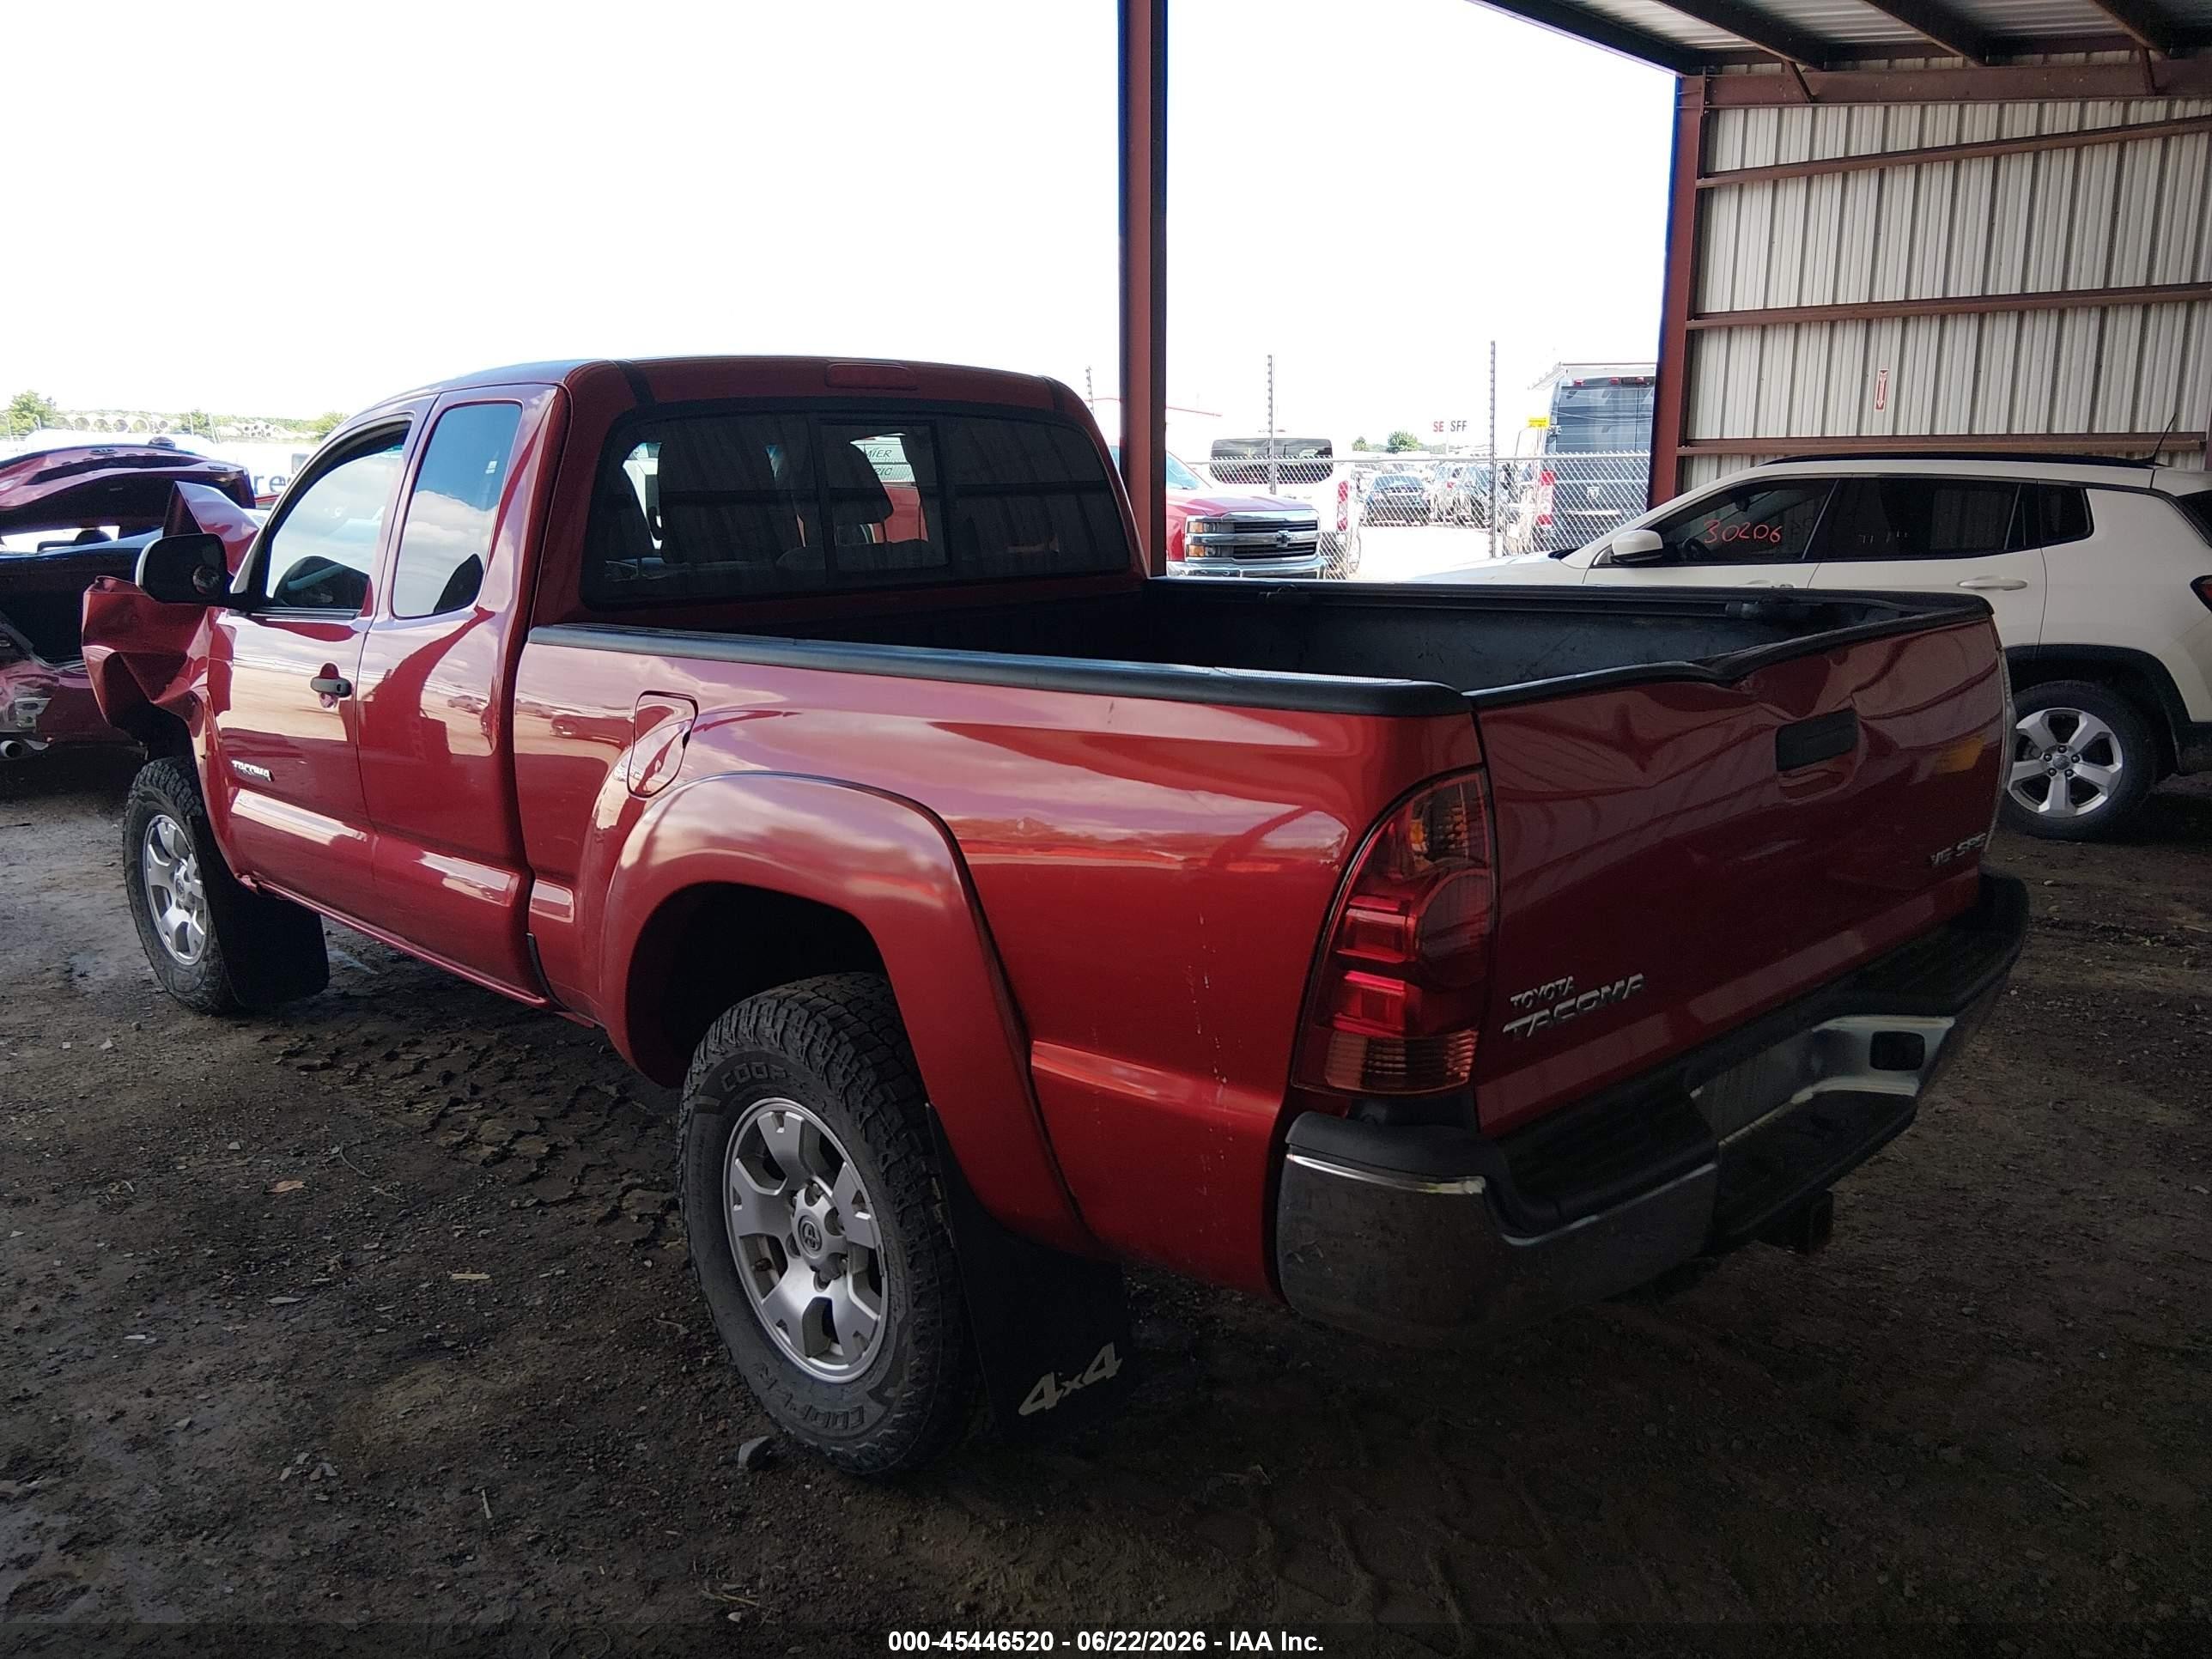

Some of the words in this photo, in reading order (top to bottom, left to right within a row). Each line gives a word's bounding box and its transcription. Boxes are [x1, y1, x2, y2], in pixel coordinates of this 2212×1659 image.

[1432, 420, 1444, 433] SE
[1703, 519, 1783, 544] 30206
[1503, 972, 1644, 1035] TACOMA
[1510, 975, 1574, 1008] TOYOTA
[1018, 1341, 1123, 1416] 4x4
